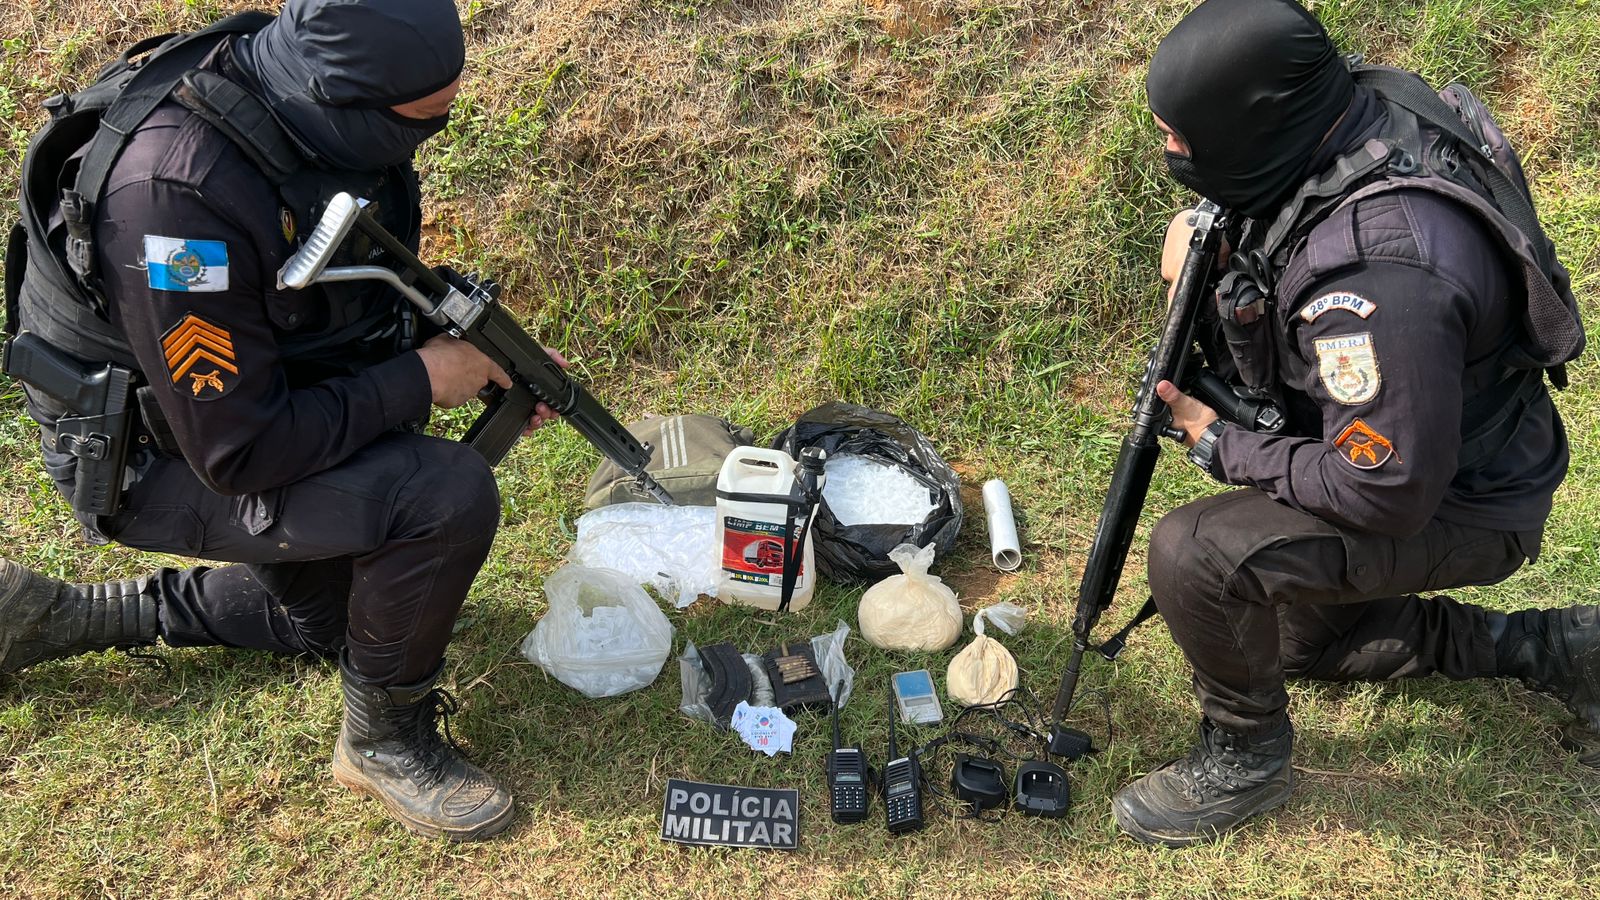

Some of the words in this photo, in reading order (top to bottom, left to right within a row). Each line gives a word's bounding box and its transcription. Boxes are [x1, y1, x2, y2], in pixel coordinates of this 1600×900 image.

[1332, 295, 1364, 311] BPM
[1319, 335, 1367, 351] PMERJ
[669, 788, 793, 820] POLÍCIA
[665, 814, 793, 845] MILITAR
